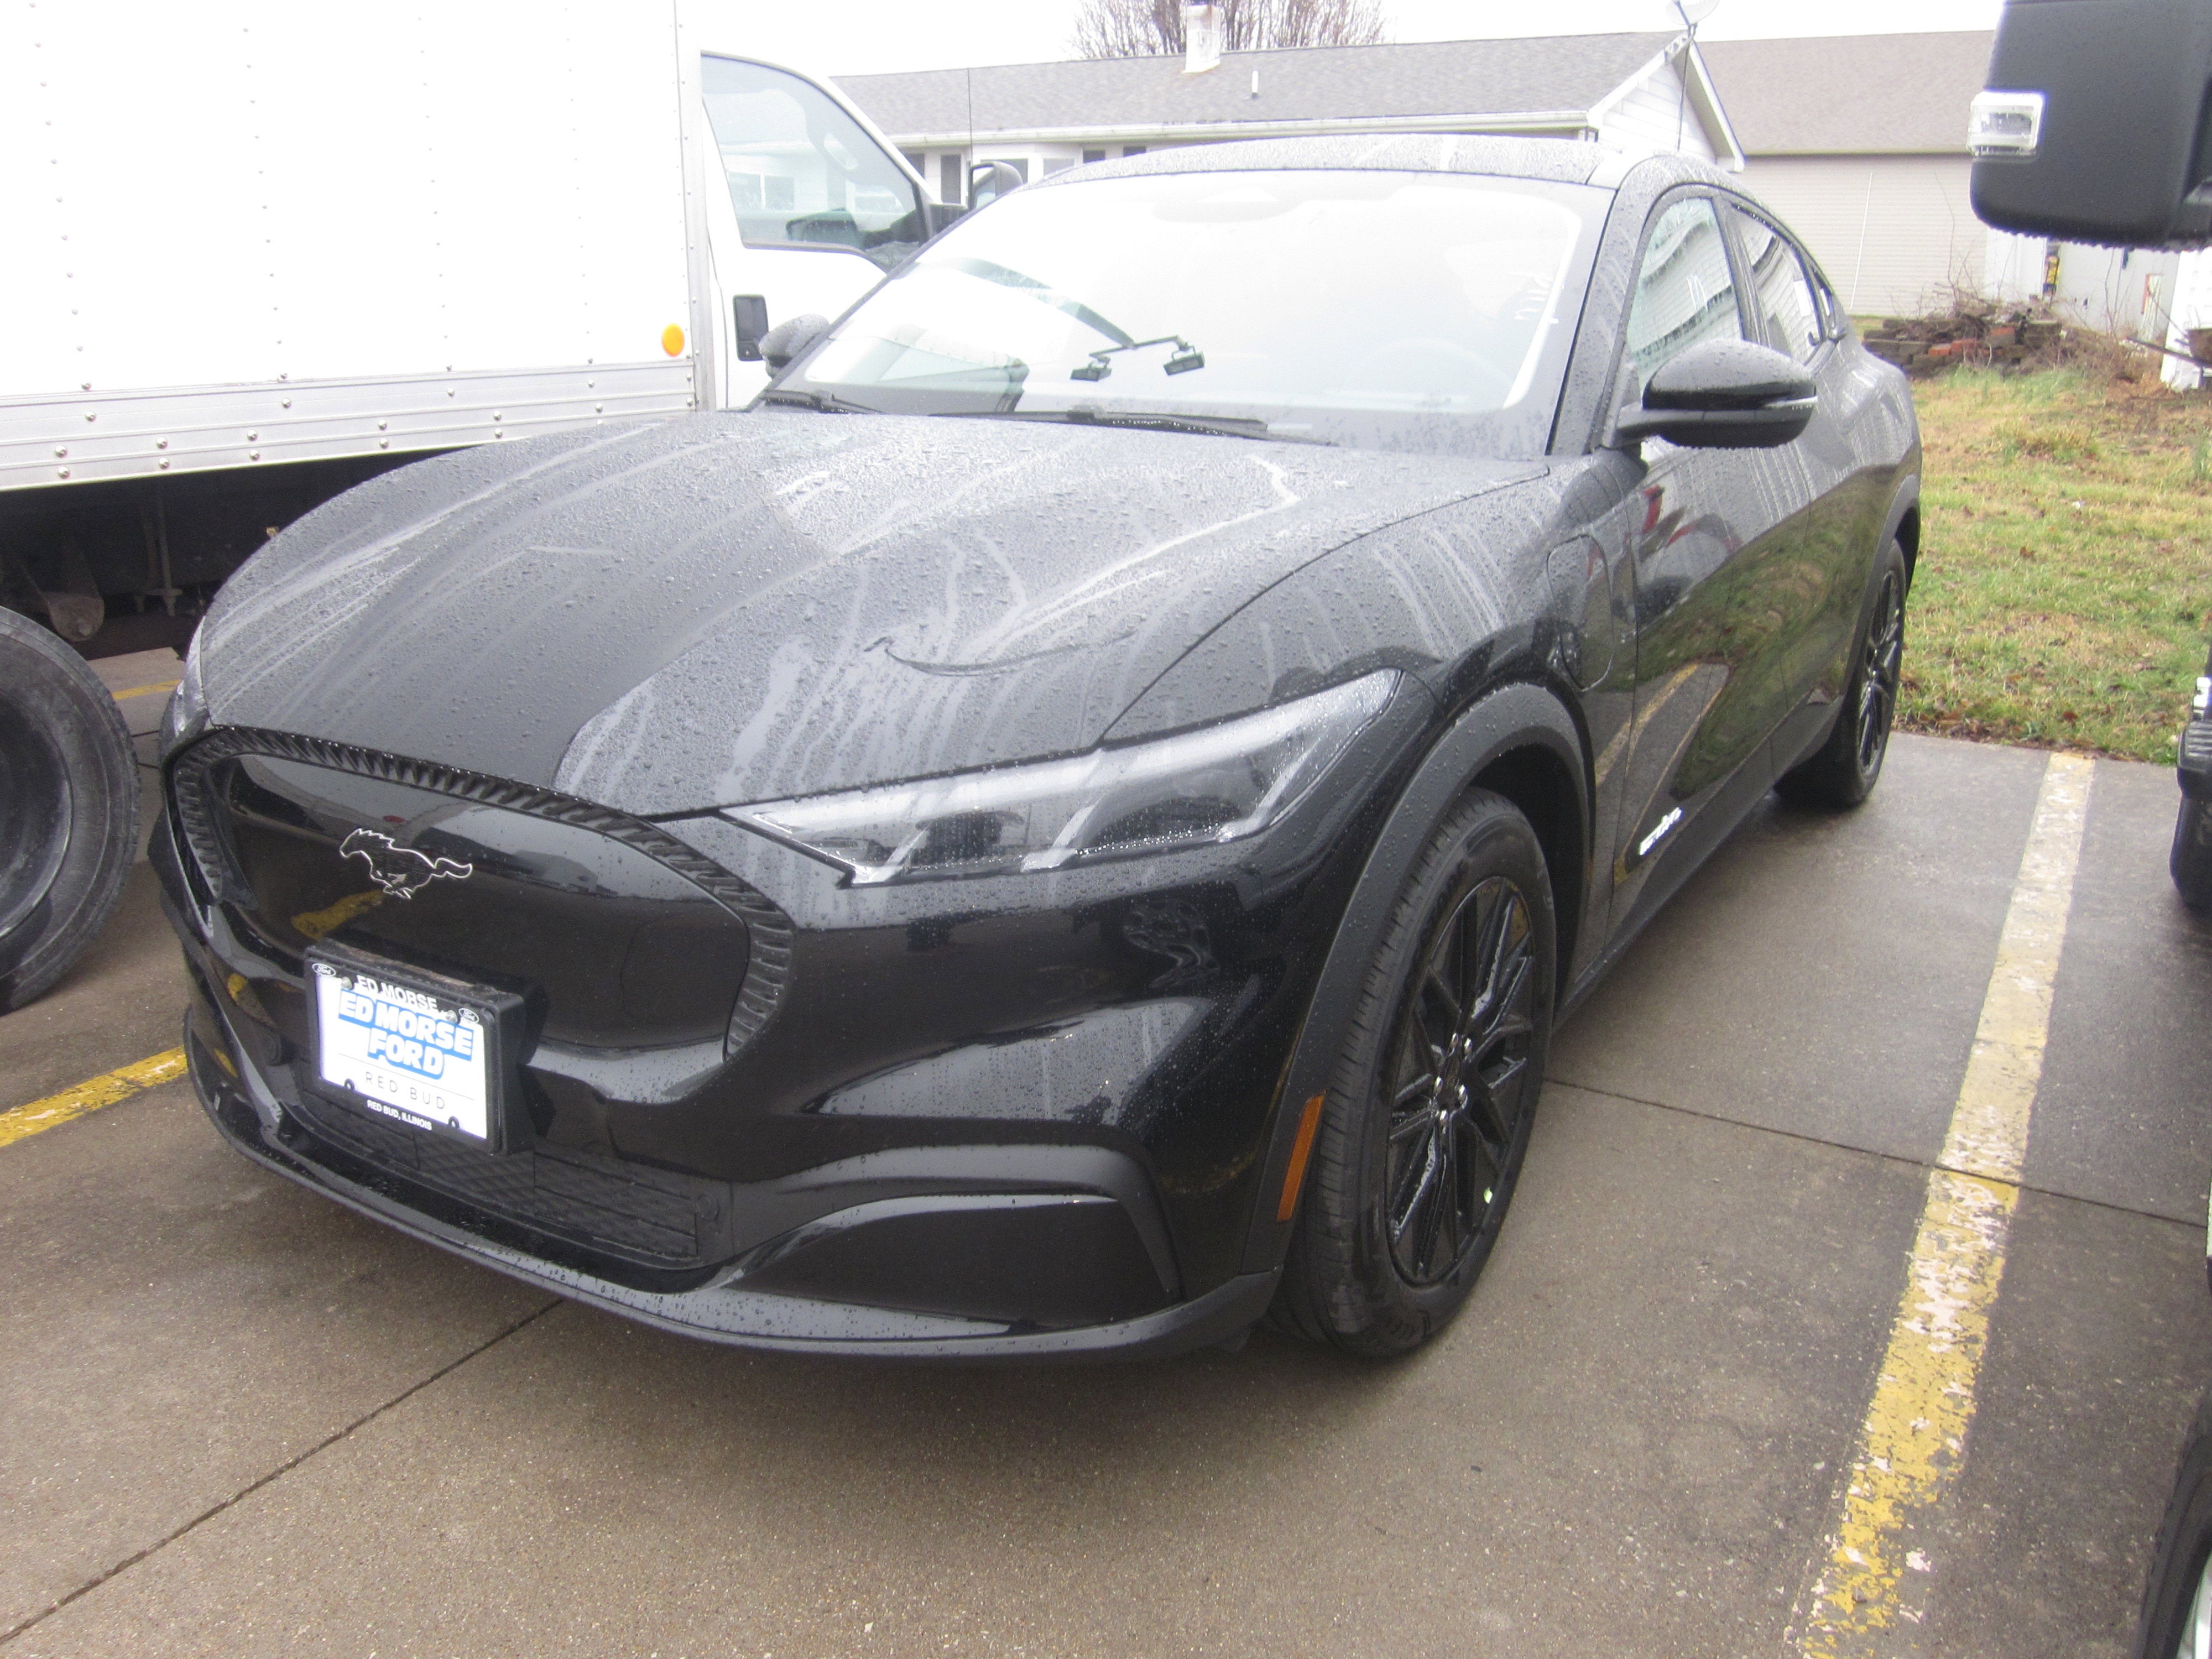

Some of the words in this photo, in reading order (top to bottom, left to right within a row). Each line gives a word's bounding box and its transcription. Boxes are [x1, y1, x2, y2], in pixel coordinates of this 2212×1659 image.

[356, 974, 379, 994] ED
[380, 982, 439, 1014] MORSE
[338, 989, 375, 1027] ED
[374, 999, 474, 1062] MORSE
[367, 1027, 445, 1080] FORD
[365, 1071, 398, 1093] RED
[410, 1086, 446, 1110] BUD
[367, 1099, 383, 1113] RED
[401, 1111, 432, 1131] ILLINOIS
